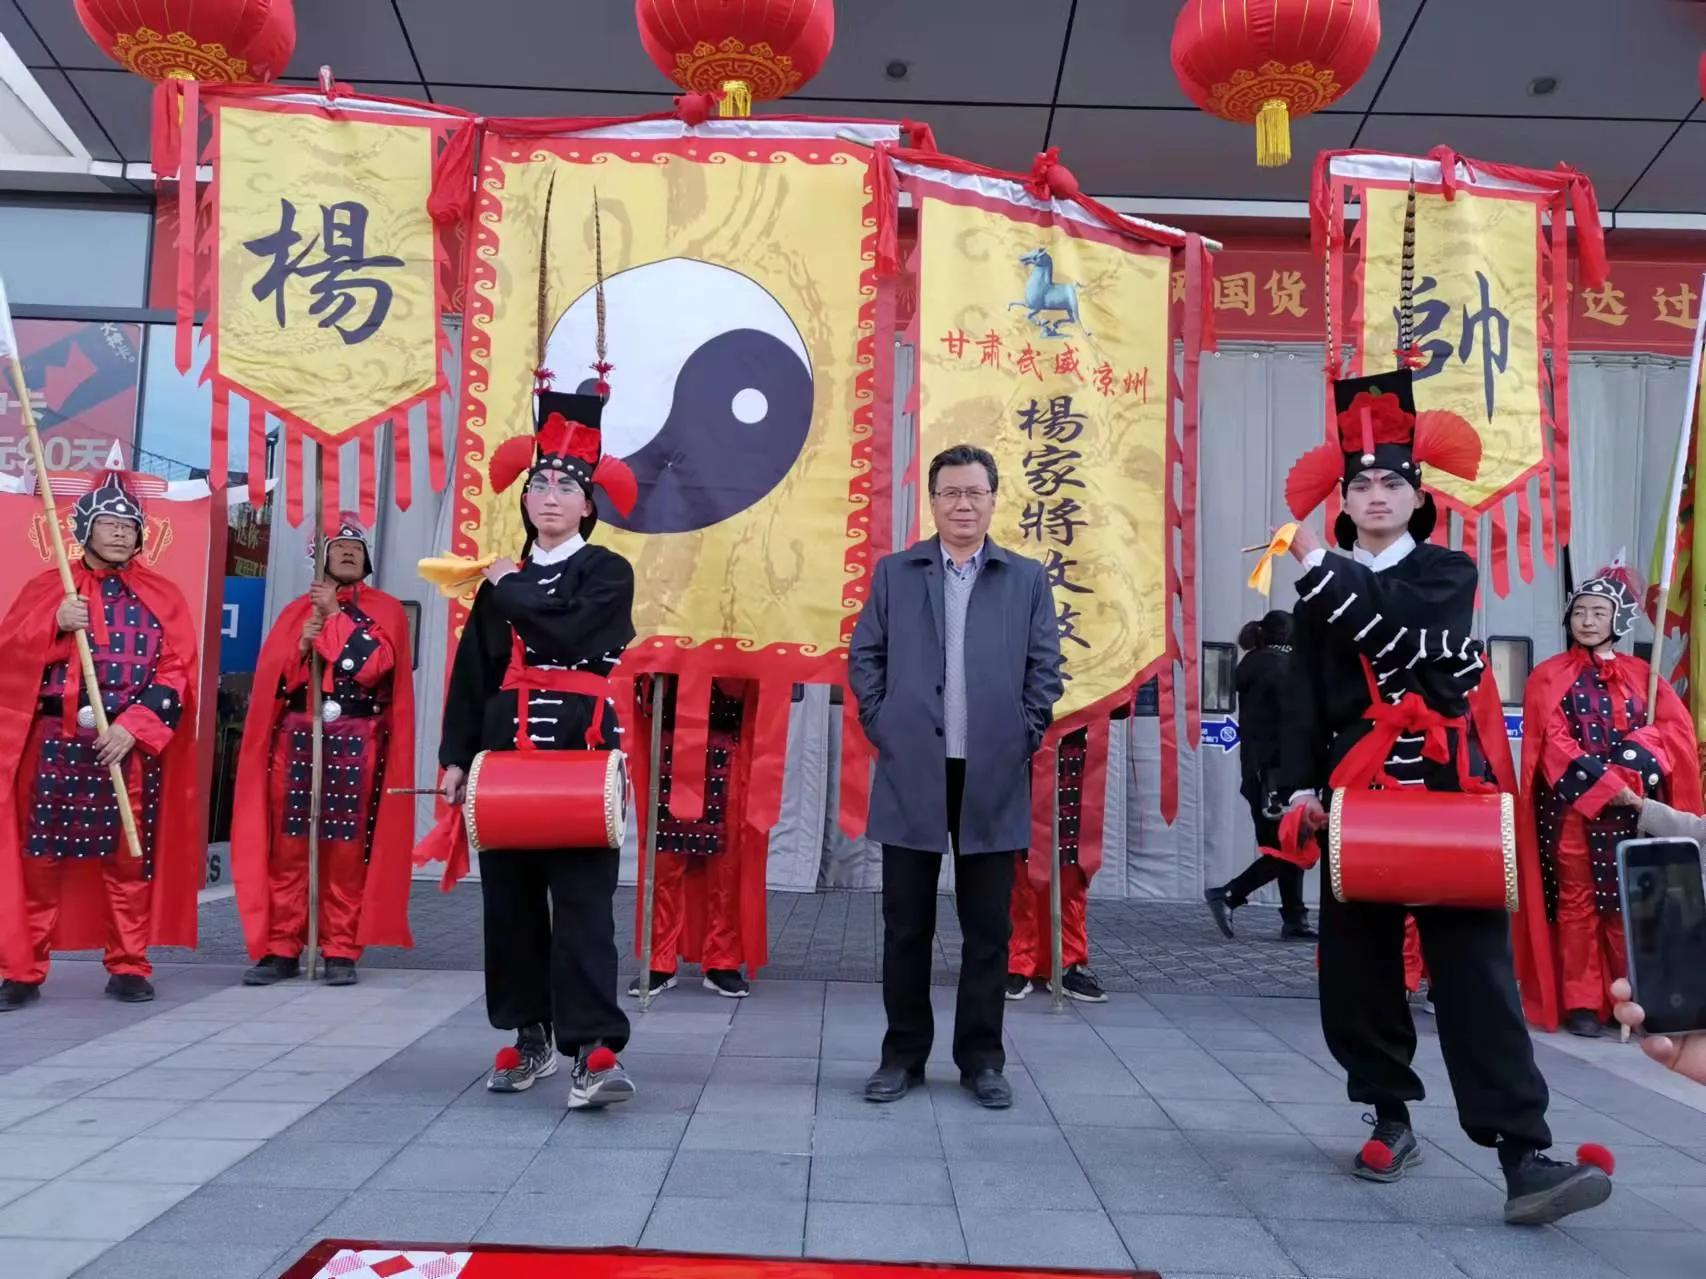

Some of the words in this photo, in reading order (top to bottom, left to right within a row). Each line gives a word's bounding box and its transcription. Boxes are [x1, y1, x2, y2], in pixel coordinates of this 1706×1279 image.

[243, 198, 405, 345] 楊
[1172, 269, 1309, 318] 国货
[1016, 395, 1095, 682] 楊家將
[207, 854, 221, 883] S
